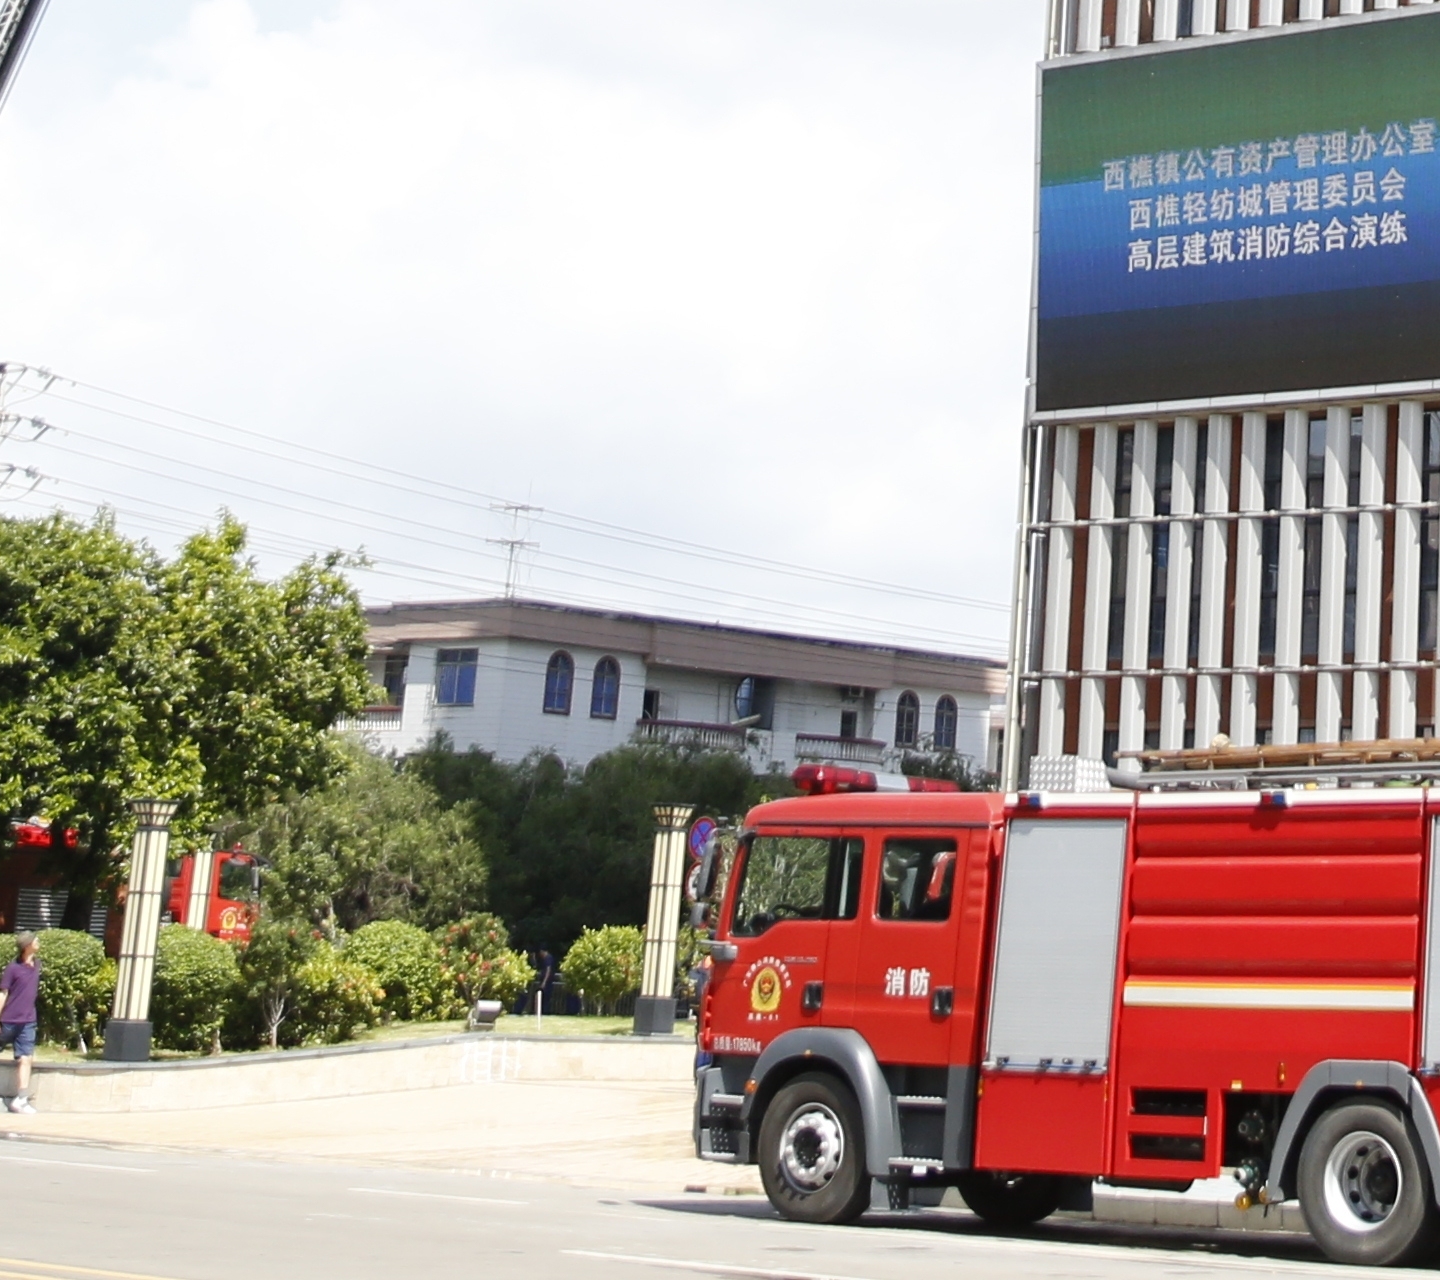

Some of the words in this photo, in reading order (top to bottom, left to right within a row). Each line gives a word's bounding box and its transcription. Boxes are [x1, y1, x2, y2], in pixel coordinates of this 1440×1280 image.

[1103, 117, 1437, 192] 西樵镇公有资产管理办公室
[1128, 166, 1407, 231] 西樵轻纺城管理委员会
[1127, 210, 1408, 273] 高层建筑消防综合演练
[884, 966, 931, 997] 消防
